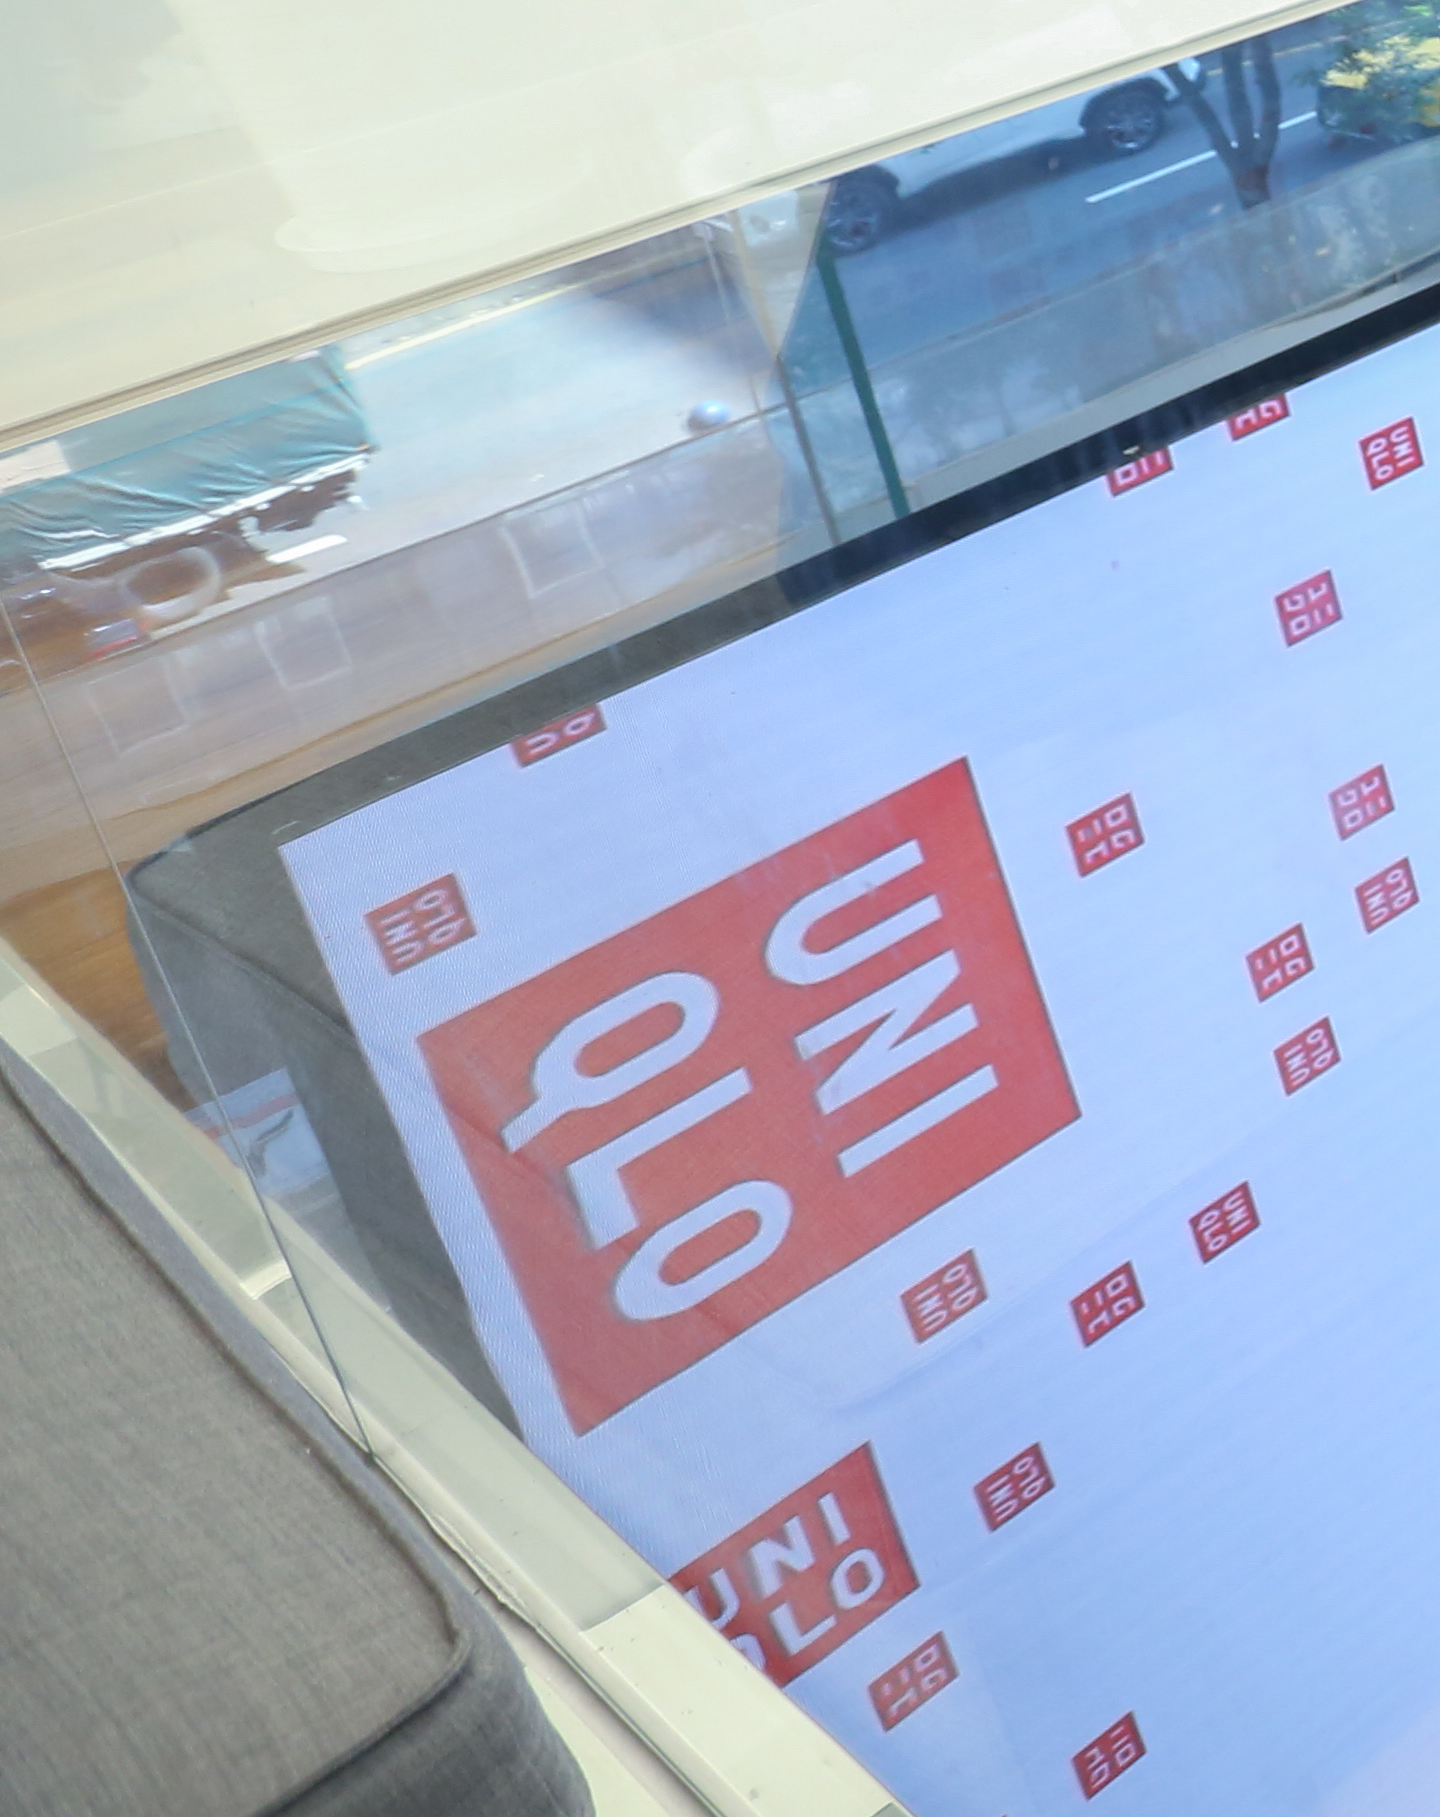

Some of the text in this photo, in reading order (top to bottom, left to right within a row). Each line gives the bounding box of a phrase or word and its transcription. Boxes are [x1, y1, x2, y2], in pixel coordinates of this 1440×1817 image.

[1367, 437, 1393, 478] QLO
[1390, 425, 1415, 467] UNI
[763, 839, 997, 1175] UNI
[501, 971, 794, 1321] QLO
